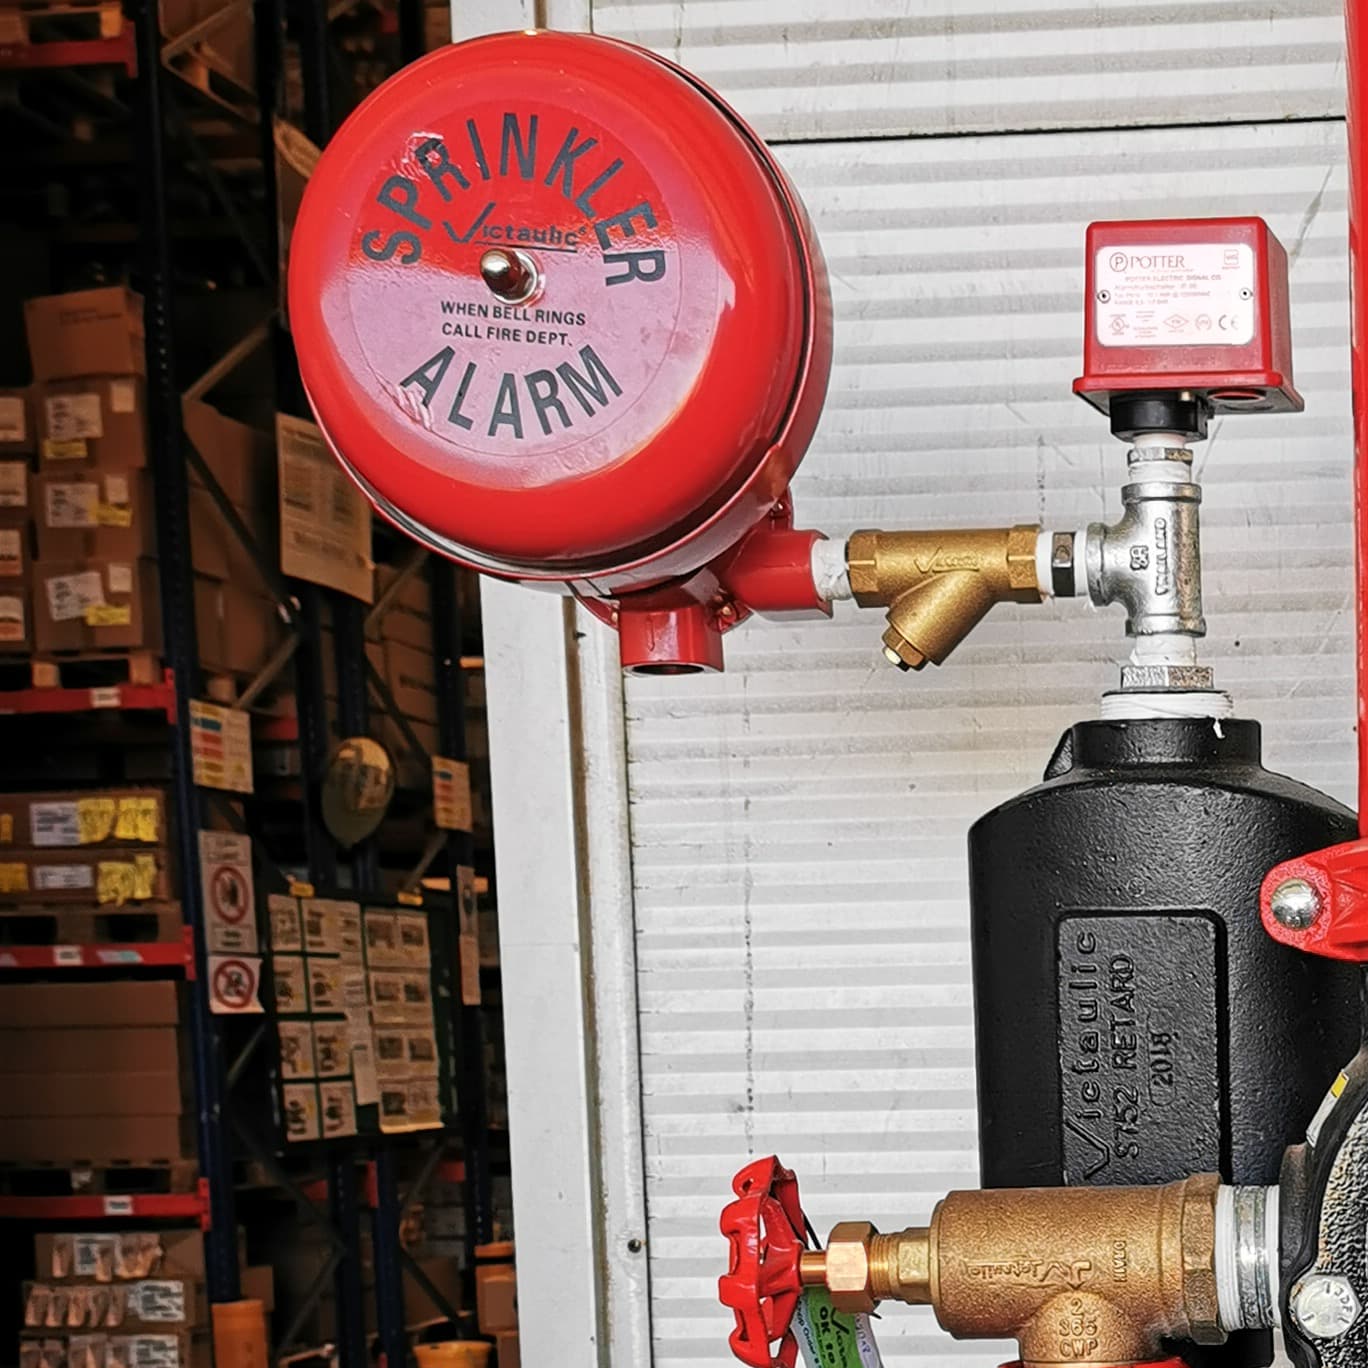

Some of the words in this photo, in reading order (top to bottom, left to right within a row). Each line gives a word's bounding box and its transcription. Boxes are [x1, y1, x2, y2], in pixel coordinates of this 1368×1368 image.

[362, 113, 666, 286] SPRINKLER
[1130, 255, 1186, 269] POTTER
[441, 301, 488, 319] WHEN
[493, 306, 531, 322] BELL
[535, 310, 586, 325] RINGS
[442, 323, 481, 340] CALL
[487, 326, 521, 343] FIRE
[525, 330, 572, 347] DEPT.
[400, 345, 623, 438] ALARM
[1110, 953, 1137, 1070] RETARD
[820, 1306, 831, 1335] OK
[1060, 1339, 1098, 1358] CWP
